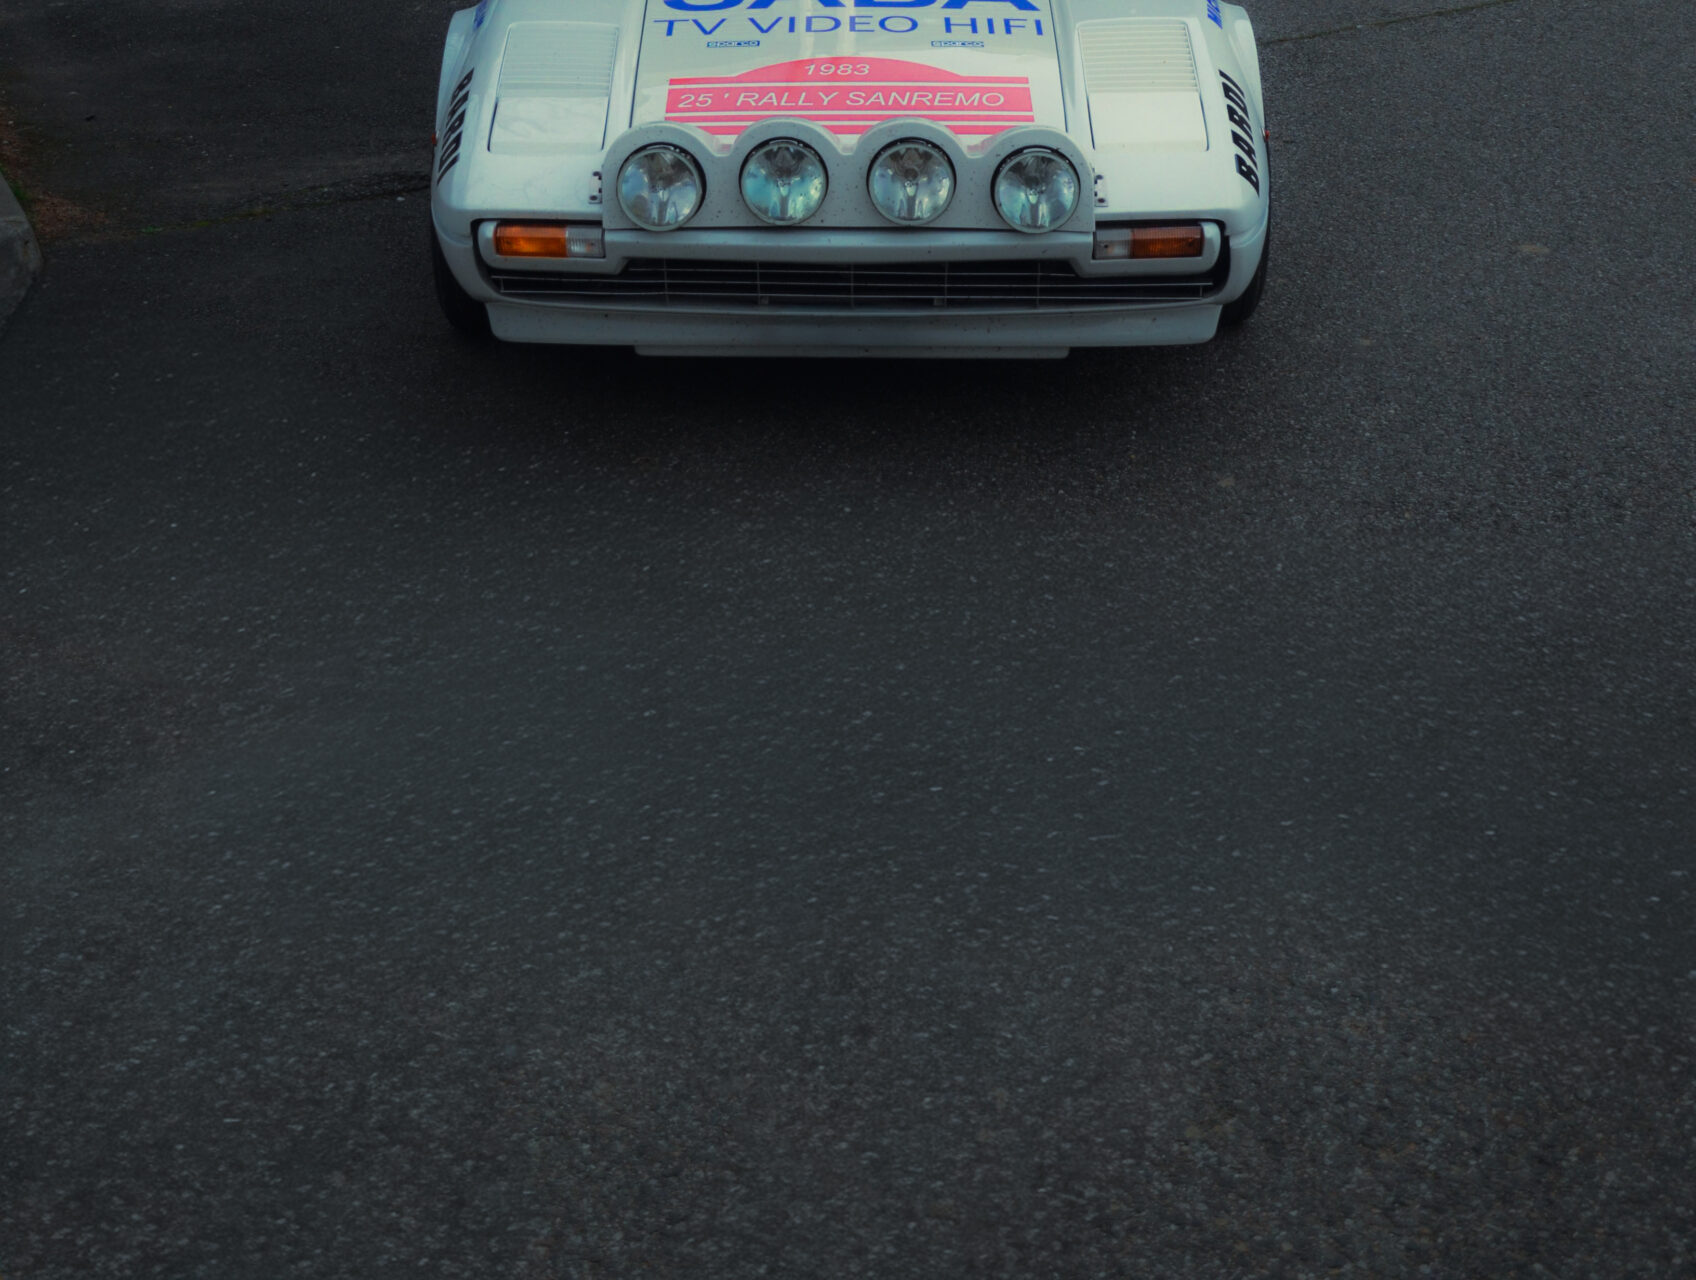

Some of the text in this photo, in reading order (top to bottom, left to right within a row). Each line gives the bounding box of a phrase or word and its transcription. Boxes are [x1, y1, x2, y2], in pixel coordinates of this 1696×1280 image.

[653, 15, 1043, 37] TV VIDEO HIFI
[803, 62, 870, 76] 1983
[736, 90, 839, 107] RALLY
[846, 90, 1005, 107] SANREMO
[1218, 68, 1260, 199] BARDI
